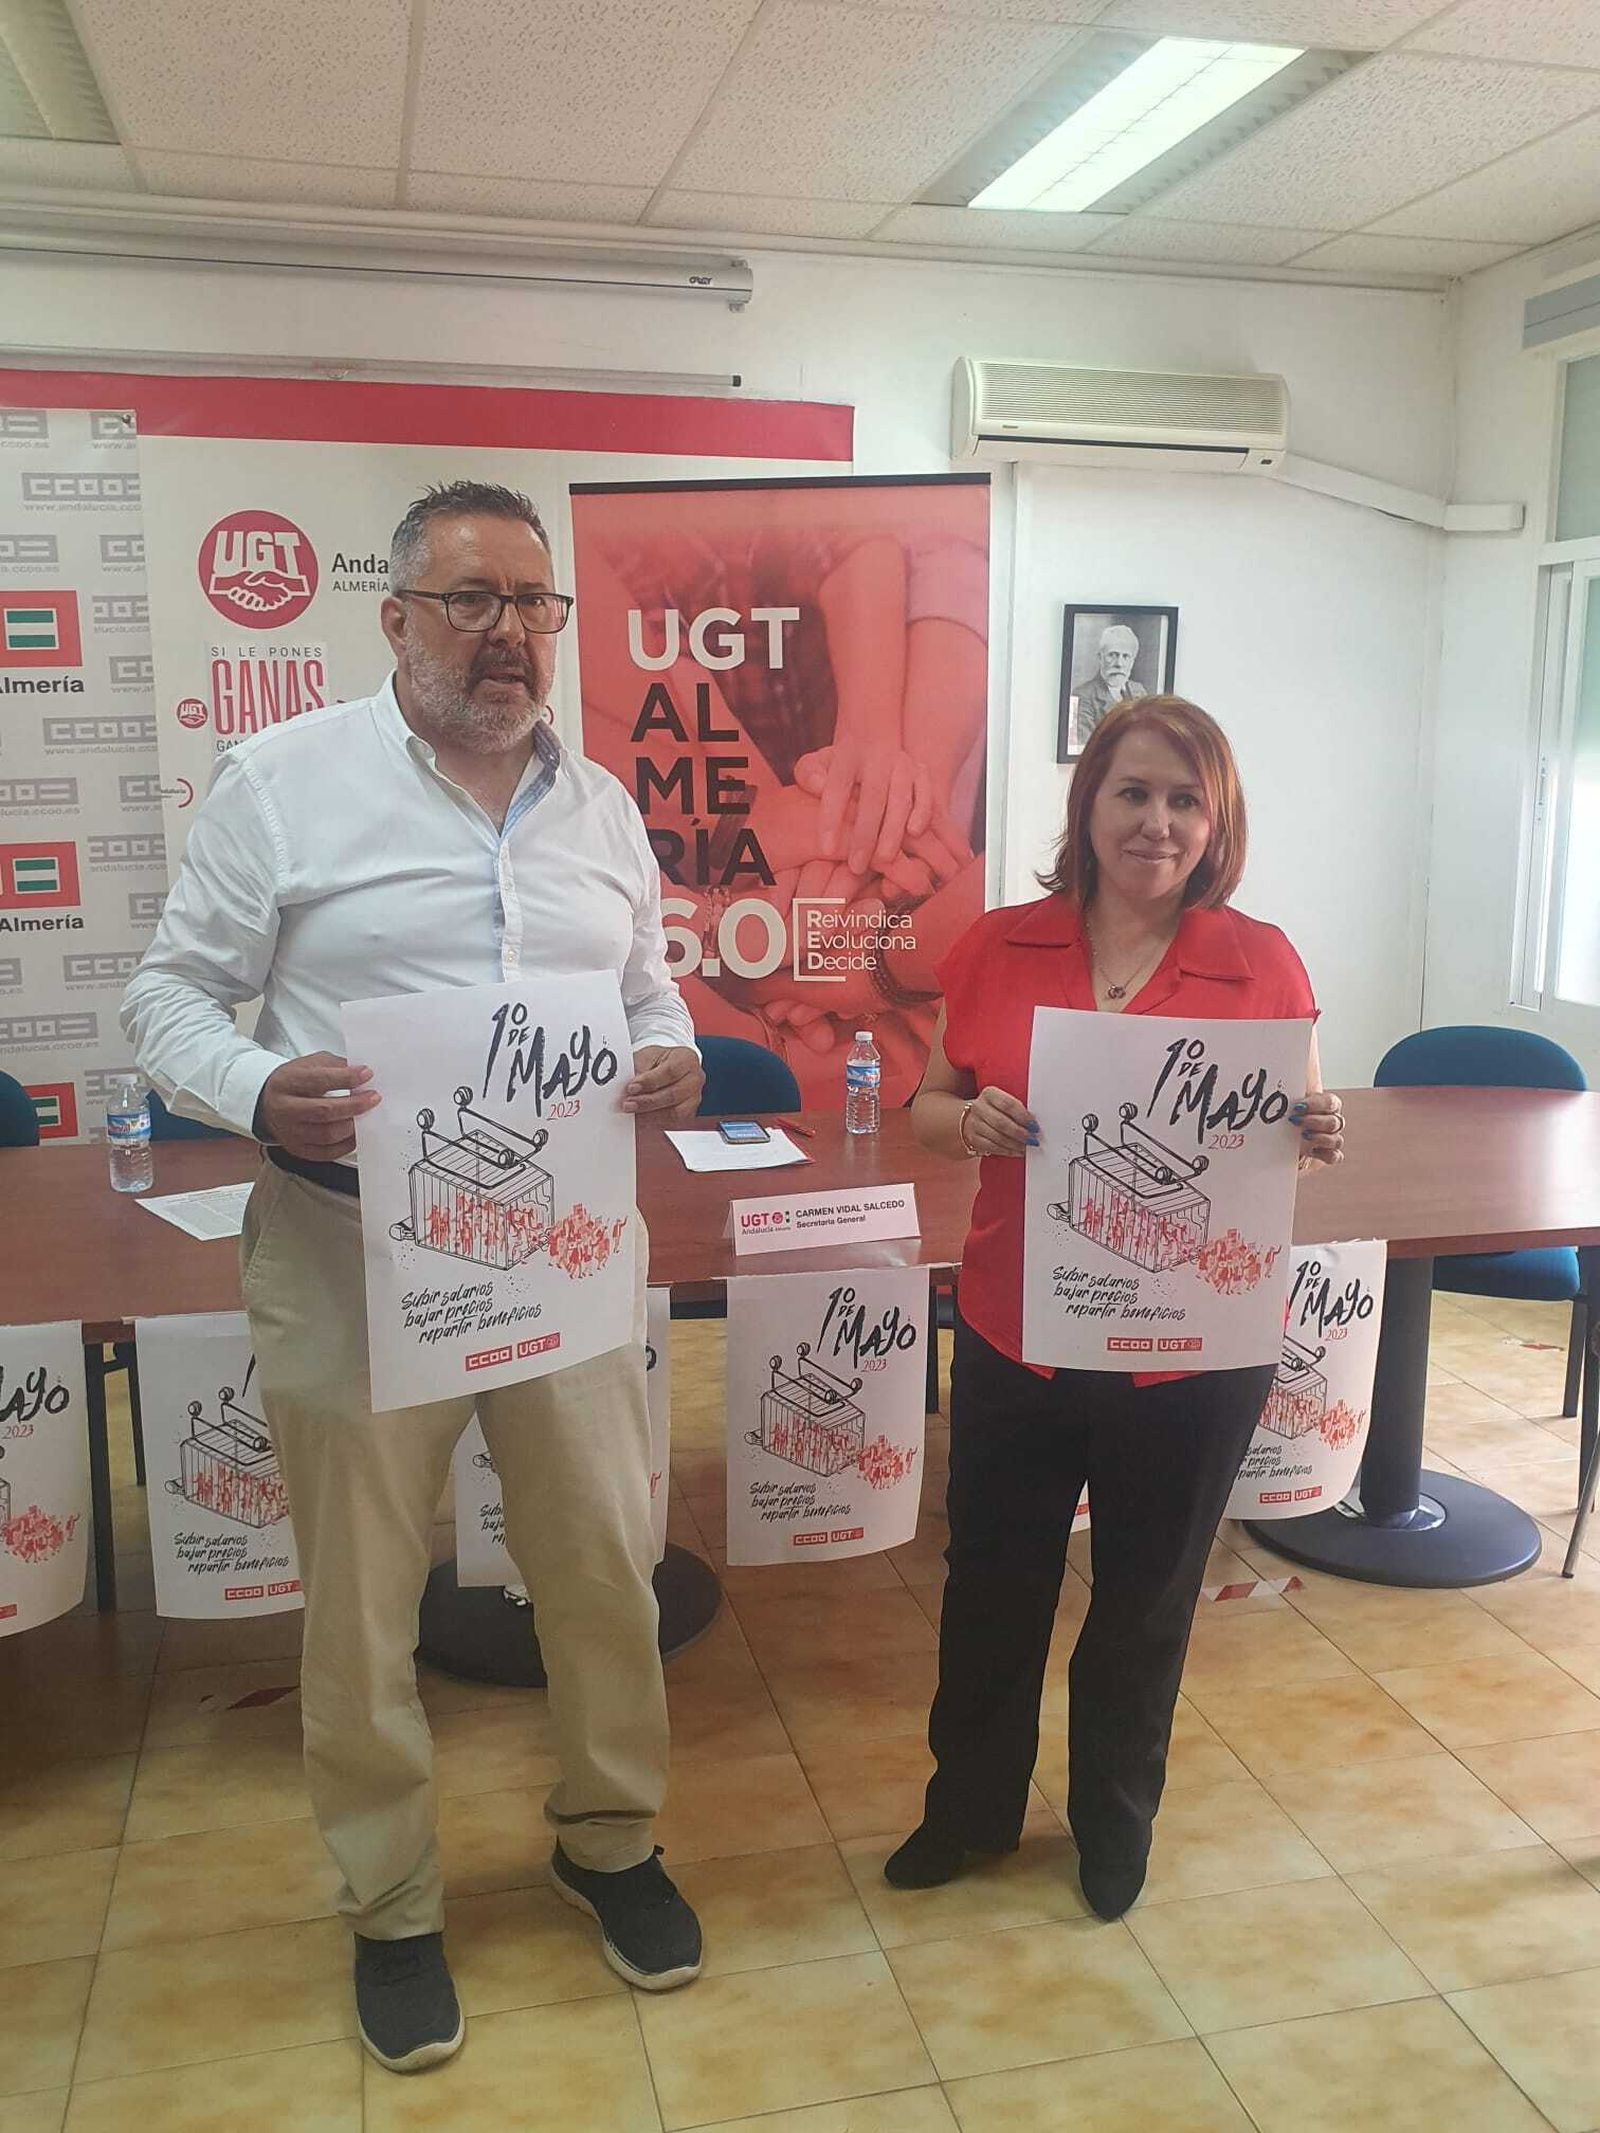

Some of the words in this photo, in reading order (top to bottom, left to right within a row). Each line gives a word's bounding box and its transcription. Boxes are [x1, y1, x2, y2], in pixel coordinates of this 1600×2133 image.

[213, 531, 301, 575] UGT
[333, 580, 390, 592] ALMERÍA
[627, 607, 800, 671] UGT
[211, 646, 226, 657] SI
[238, 646, 257, 657] LE
[269, 646, 322, 657] PONES
[212, 659, 325, 735] GANAS
[180, 703, 204, 716] UGT
[630, 682, 739, 742] AL
[635, 756, 750, 815] ME
[650, 818, 776, 886] RÍA
[0, 914, 84, 932] Almería
[807, 909, 913, 929] Reivindica
[661, 897, 787, 979] 6.0
[807, 931, 916, 950] Evoluciona
[807, 951, 877, 971] Decide
[547, 1100, 581, 1121] 2023
[1208, 1134, 1244, 1149] 2023
[796, 1206, 834, 1218] CARMEN
[837, 1203, 861, 1214] VIDAL
[864, 1199, 905, 1211] SALCEDO
[741, 1213, 770, 1228] UGT
[796, 1218, 835, 1229] Secretaria
[837, 1214, 866, 1225] General
[1053, 1266, 1088, 1282] Subir
[1088, 1274, 1140, 1290] salarios
[402, 1287, 440, 1311] Subir
[441, 1281, 493, 1307] salarios
[1053, 1282, 1089, 1300] bajar
[1090, 1290, 1138, 1305] precios
[404, 1307, 442, 1329] bajar
[444, 1298, 493, 1324] precios
[1065, 1303, 1119, 1320] repartir
[1120, 1304, 1186, 1321] beneficios
[419, 1315, 476, 1344] repartir
[477, 1304, 541, 1332] beneficios
[1324, 1328, 1348, 1341] 2023
[467, 1348, 511, 1369] CCOO
[519, 1338, 546, 1356] UGT
[1108, 1339, 1151, 1350] CCOO
[1160, 1339, 1188, 1350] UGT
[861, 1359, 887, 1373] 2023
[2, 1424, 34, 1439] 2023
[1247, 1456, 1281, 1468] precios
[1269, 1465, 1313, 1478] beneficios
[749, 1481, 778, 1495] Subir
[778, 1482, 816, 1496] salarios
[1295, 1490, 1313, 1499] UGT
[751, 1495, 780, 1509] bajar
[780, 1495, 815, 1508] precios
[760, 1507, 800, 1522] repartir
[803, 1504, 851, 1518] beneficios
[174, 1531, 204, 1545] Subir
[205, 1534, 248, 1547] salarios
[794, 1534, 827, 1545] CCOO
[832, 1531, 853, 1541] UGT
[177, 1547, 206, 1560] bajar
[208, 1547, 248, 1561] precios
[188, 1558, 231, 1574] repartir
[234, 1556, 289, 1571] beneficios
[226, 1588, 262, 1599] CCOO
[269, 1583, 293, 1595] UGT
